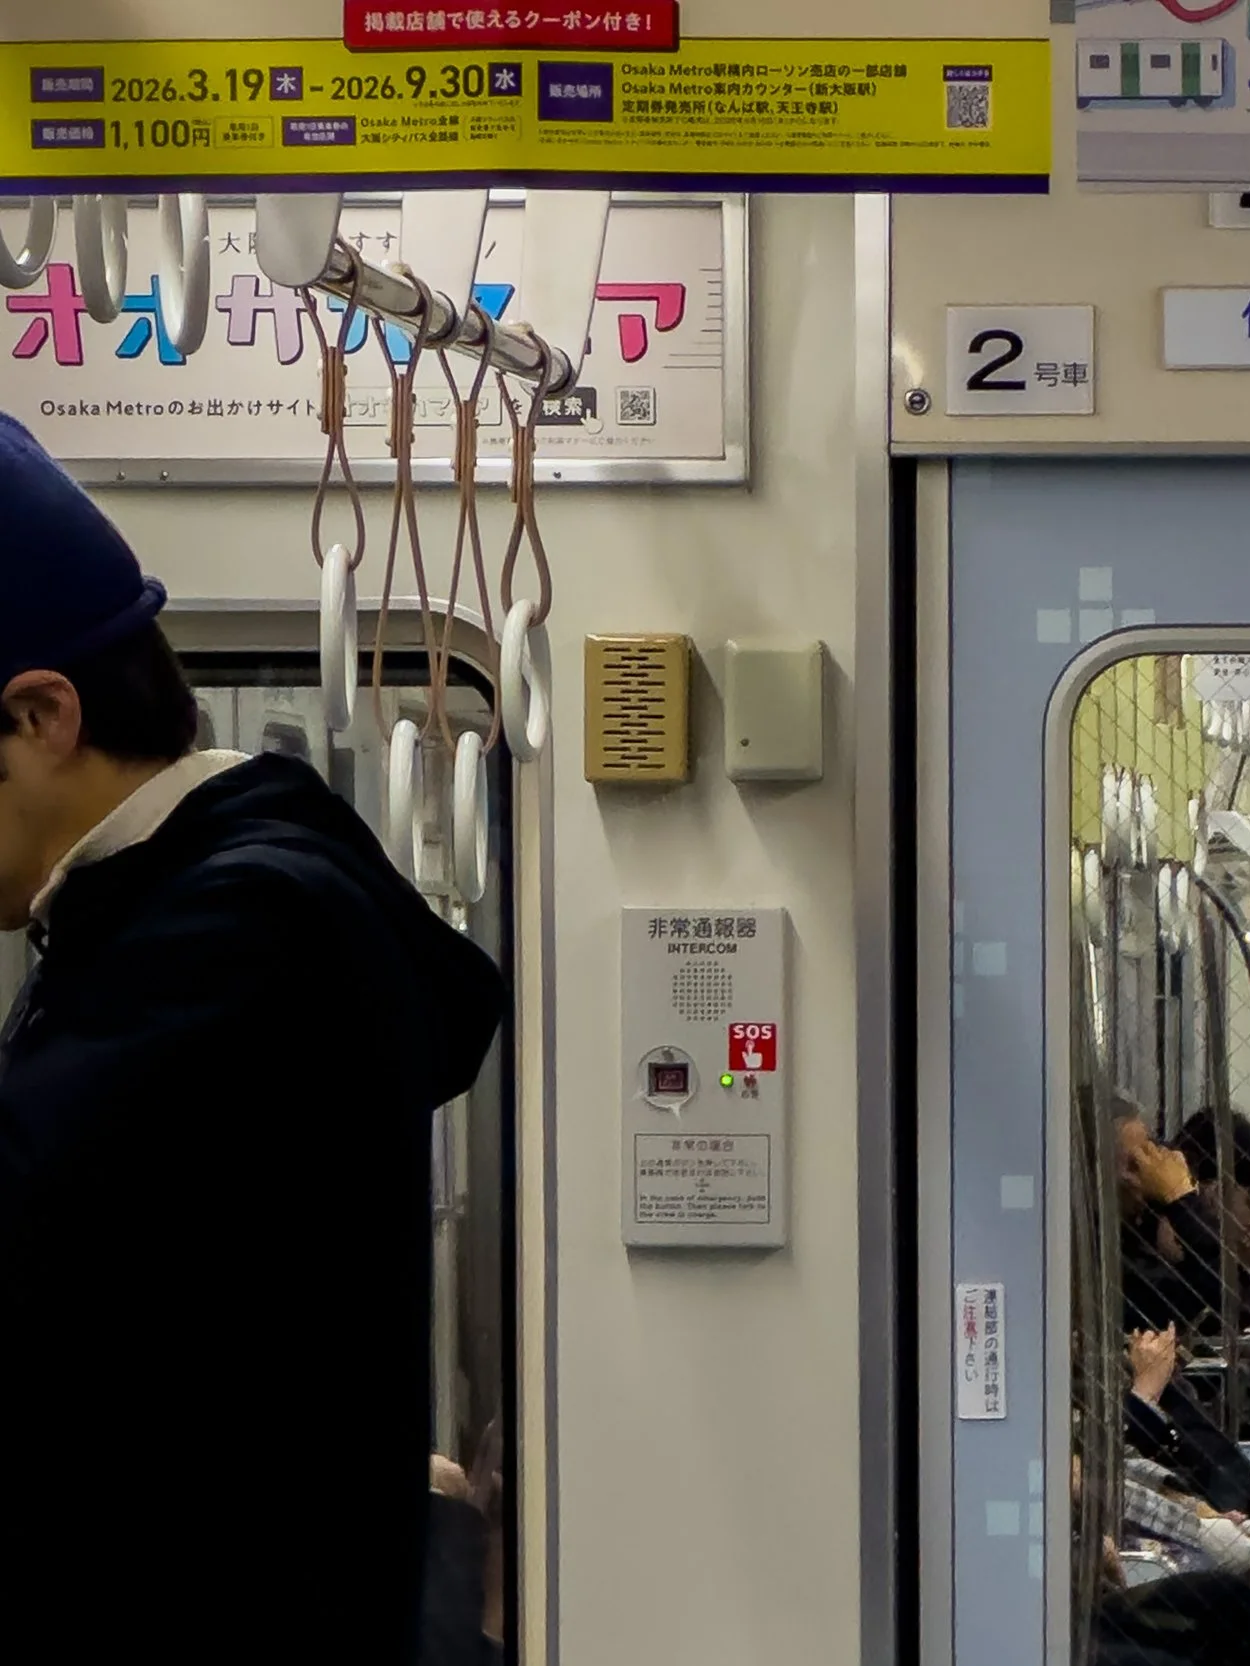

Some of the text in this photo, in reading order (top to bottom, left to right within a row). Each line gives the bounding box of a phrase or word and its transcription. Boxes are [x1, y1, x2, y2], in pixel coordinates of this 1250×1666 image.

[621, 64, 665, 77] Osaka
[111, 68, 265, 101] 2026.3.19
[275, 73, 297, 94] 木
[330, 65, 485, 100] 2026.9.30
[494, 68, 517, 90] 水
[621, 82, 665, 94] Osaka
[110, 119, 211, 151] 1,100円
[40, 398, 316, 417] Osaka Metroのお出かけサイト
[648, 917, 757, 939] 非常通報器
[667, 943, 738, 954] INTERCOM
[733, 1025, 772, 1040] SOS
